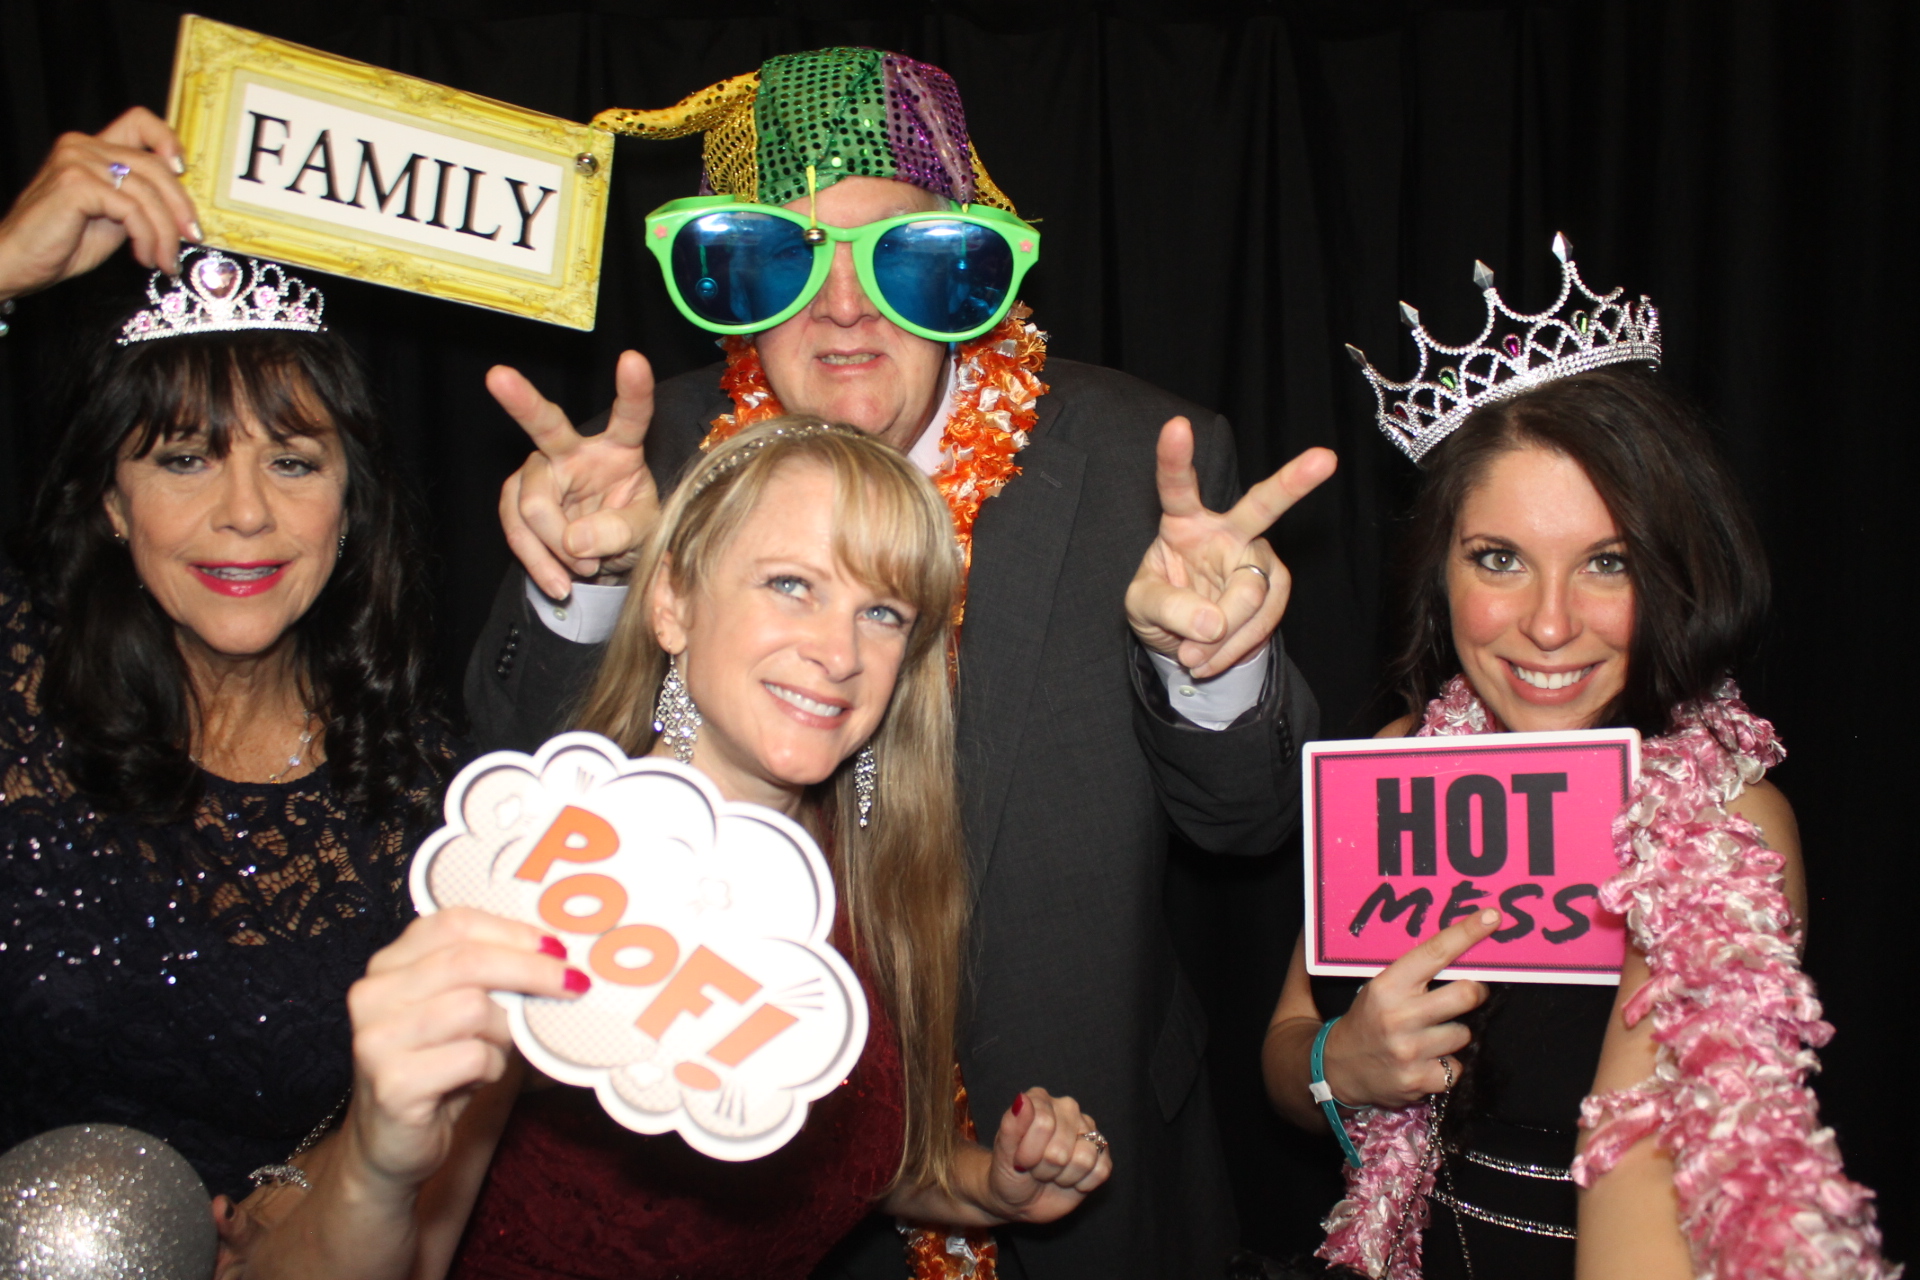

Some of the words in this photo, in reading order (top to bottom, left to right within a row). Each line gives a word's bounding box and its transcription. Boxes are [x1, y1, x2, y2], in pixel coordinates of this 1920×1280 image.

[238, 111, 557, 250] FAMILY
[1376, 773, 1568, 876] HOT
[514, 805, 799, 1090] POOF!
[1349, 880, 1599, 944] MESS
